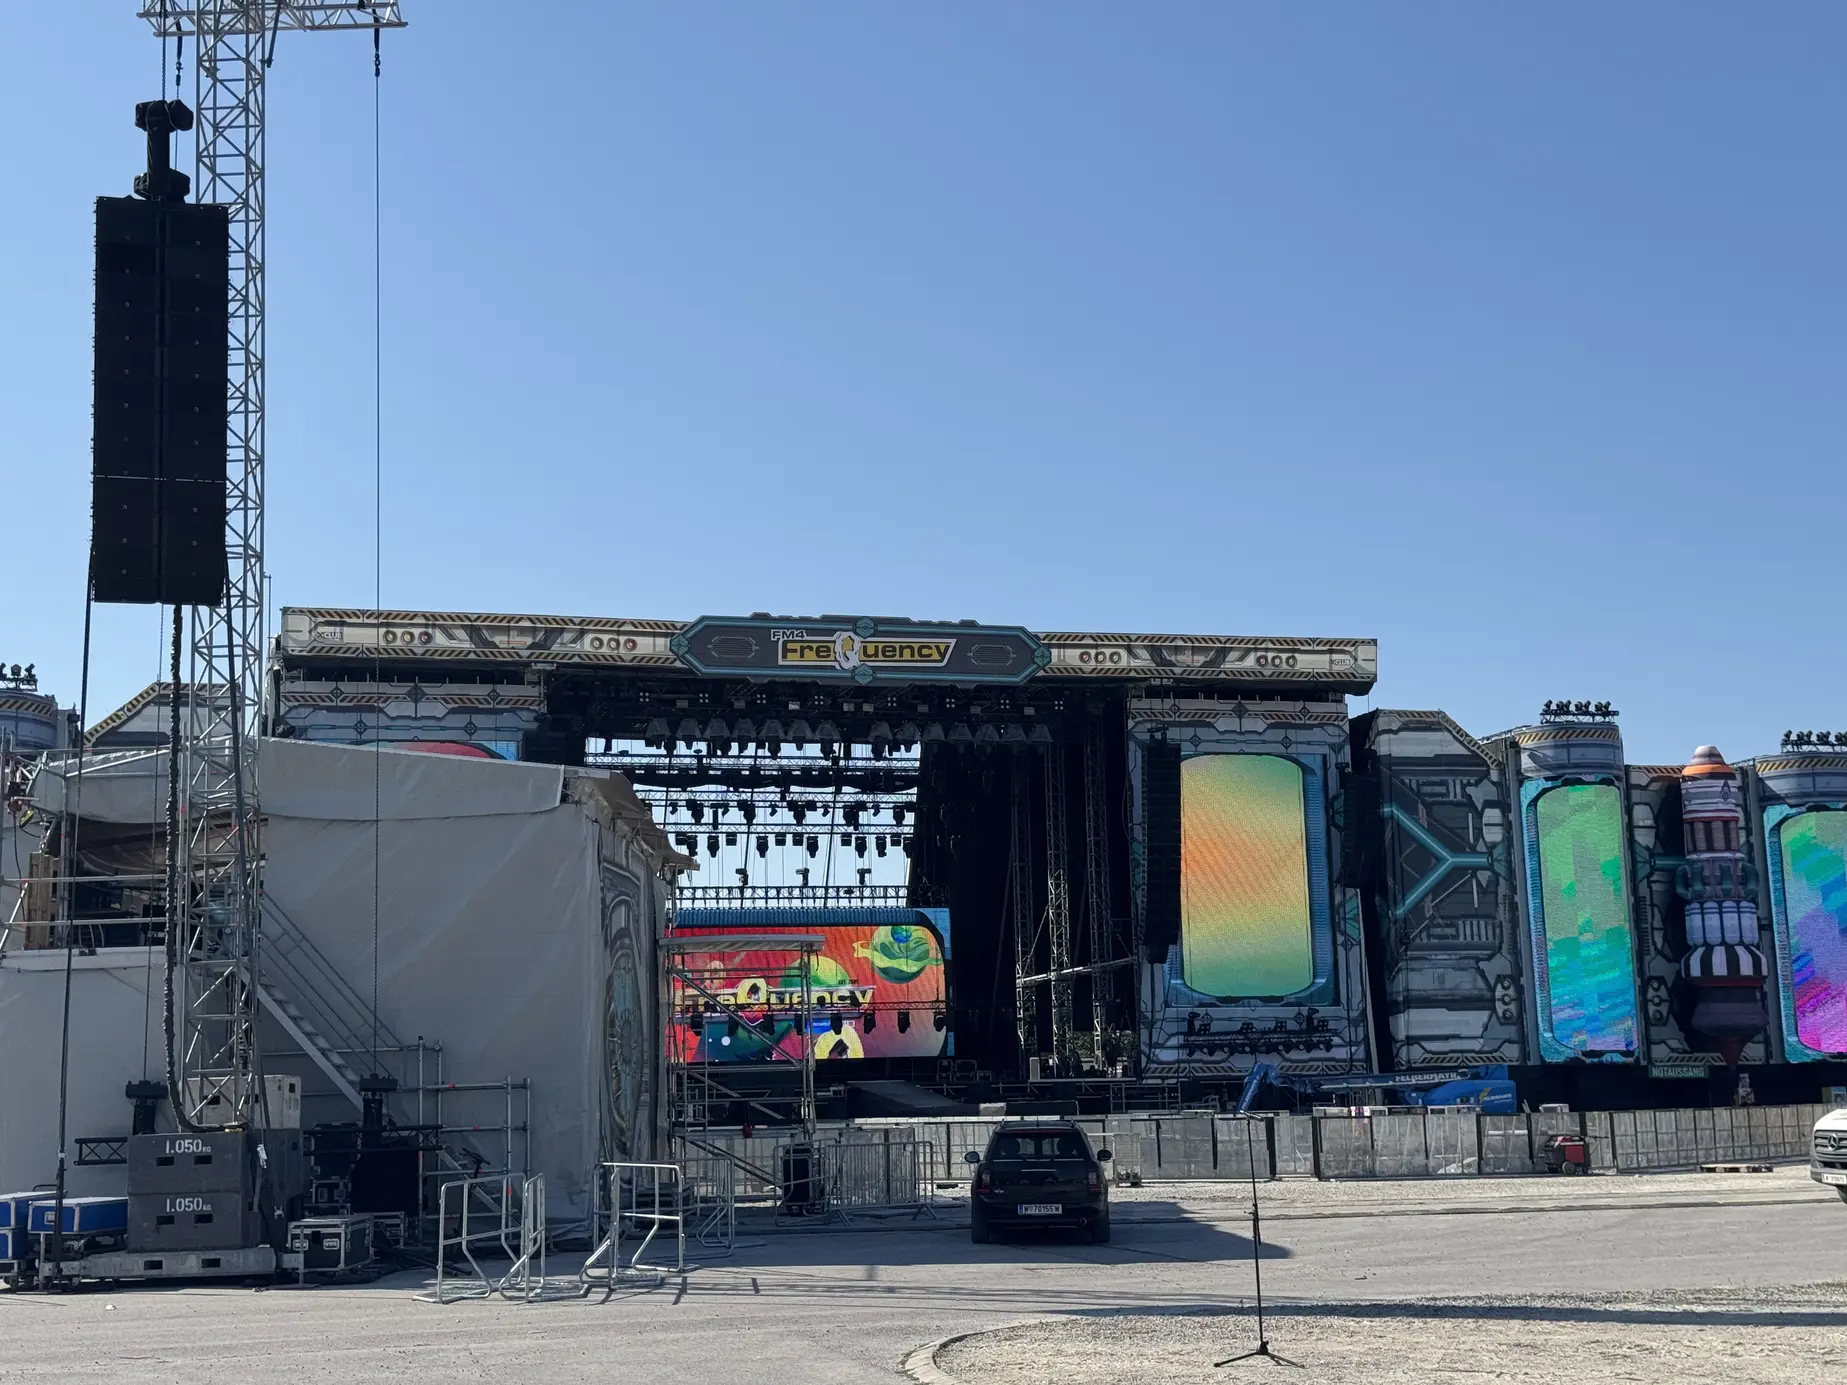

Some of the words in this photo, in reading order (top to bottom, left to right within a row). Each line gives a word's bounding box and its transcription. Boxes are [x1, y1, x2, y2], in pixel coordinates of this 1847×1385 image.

[772, 630, 806, 640] FM4
[1652, 1066, 1705, 1077] NOTAUSGANG
[165, 1138, 203, 1154] 1.050
[166, 1197, 203, 1213] 1.050
